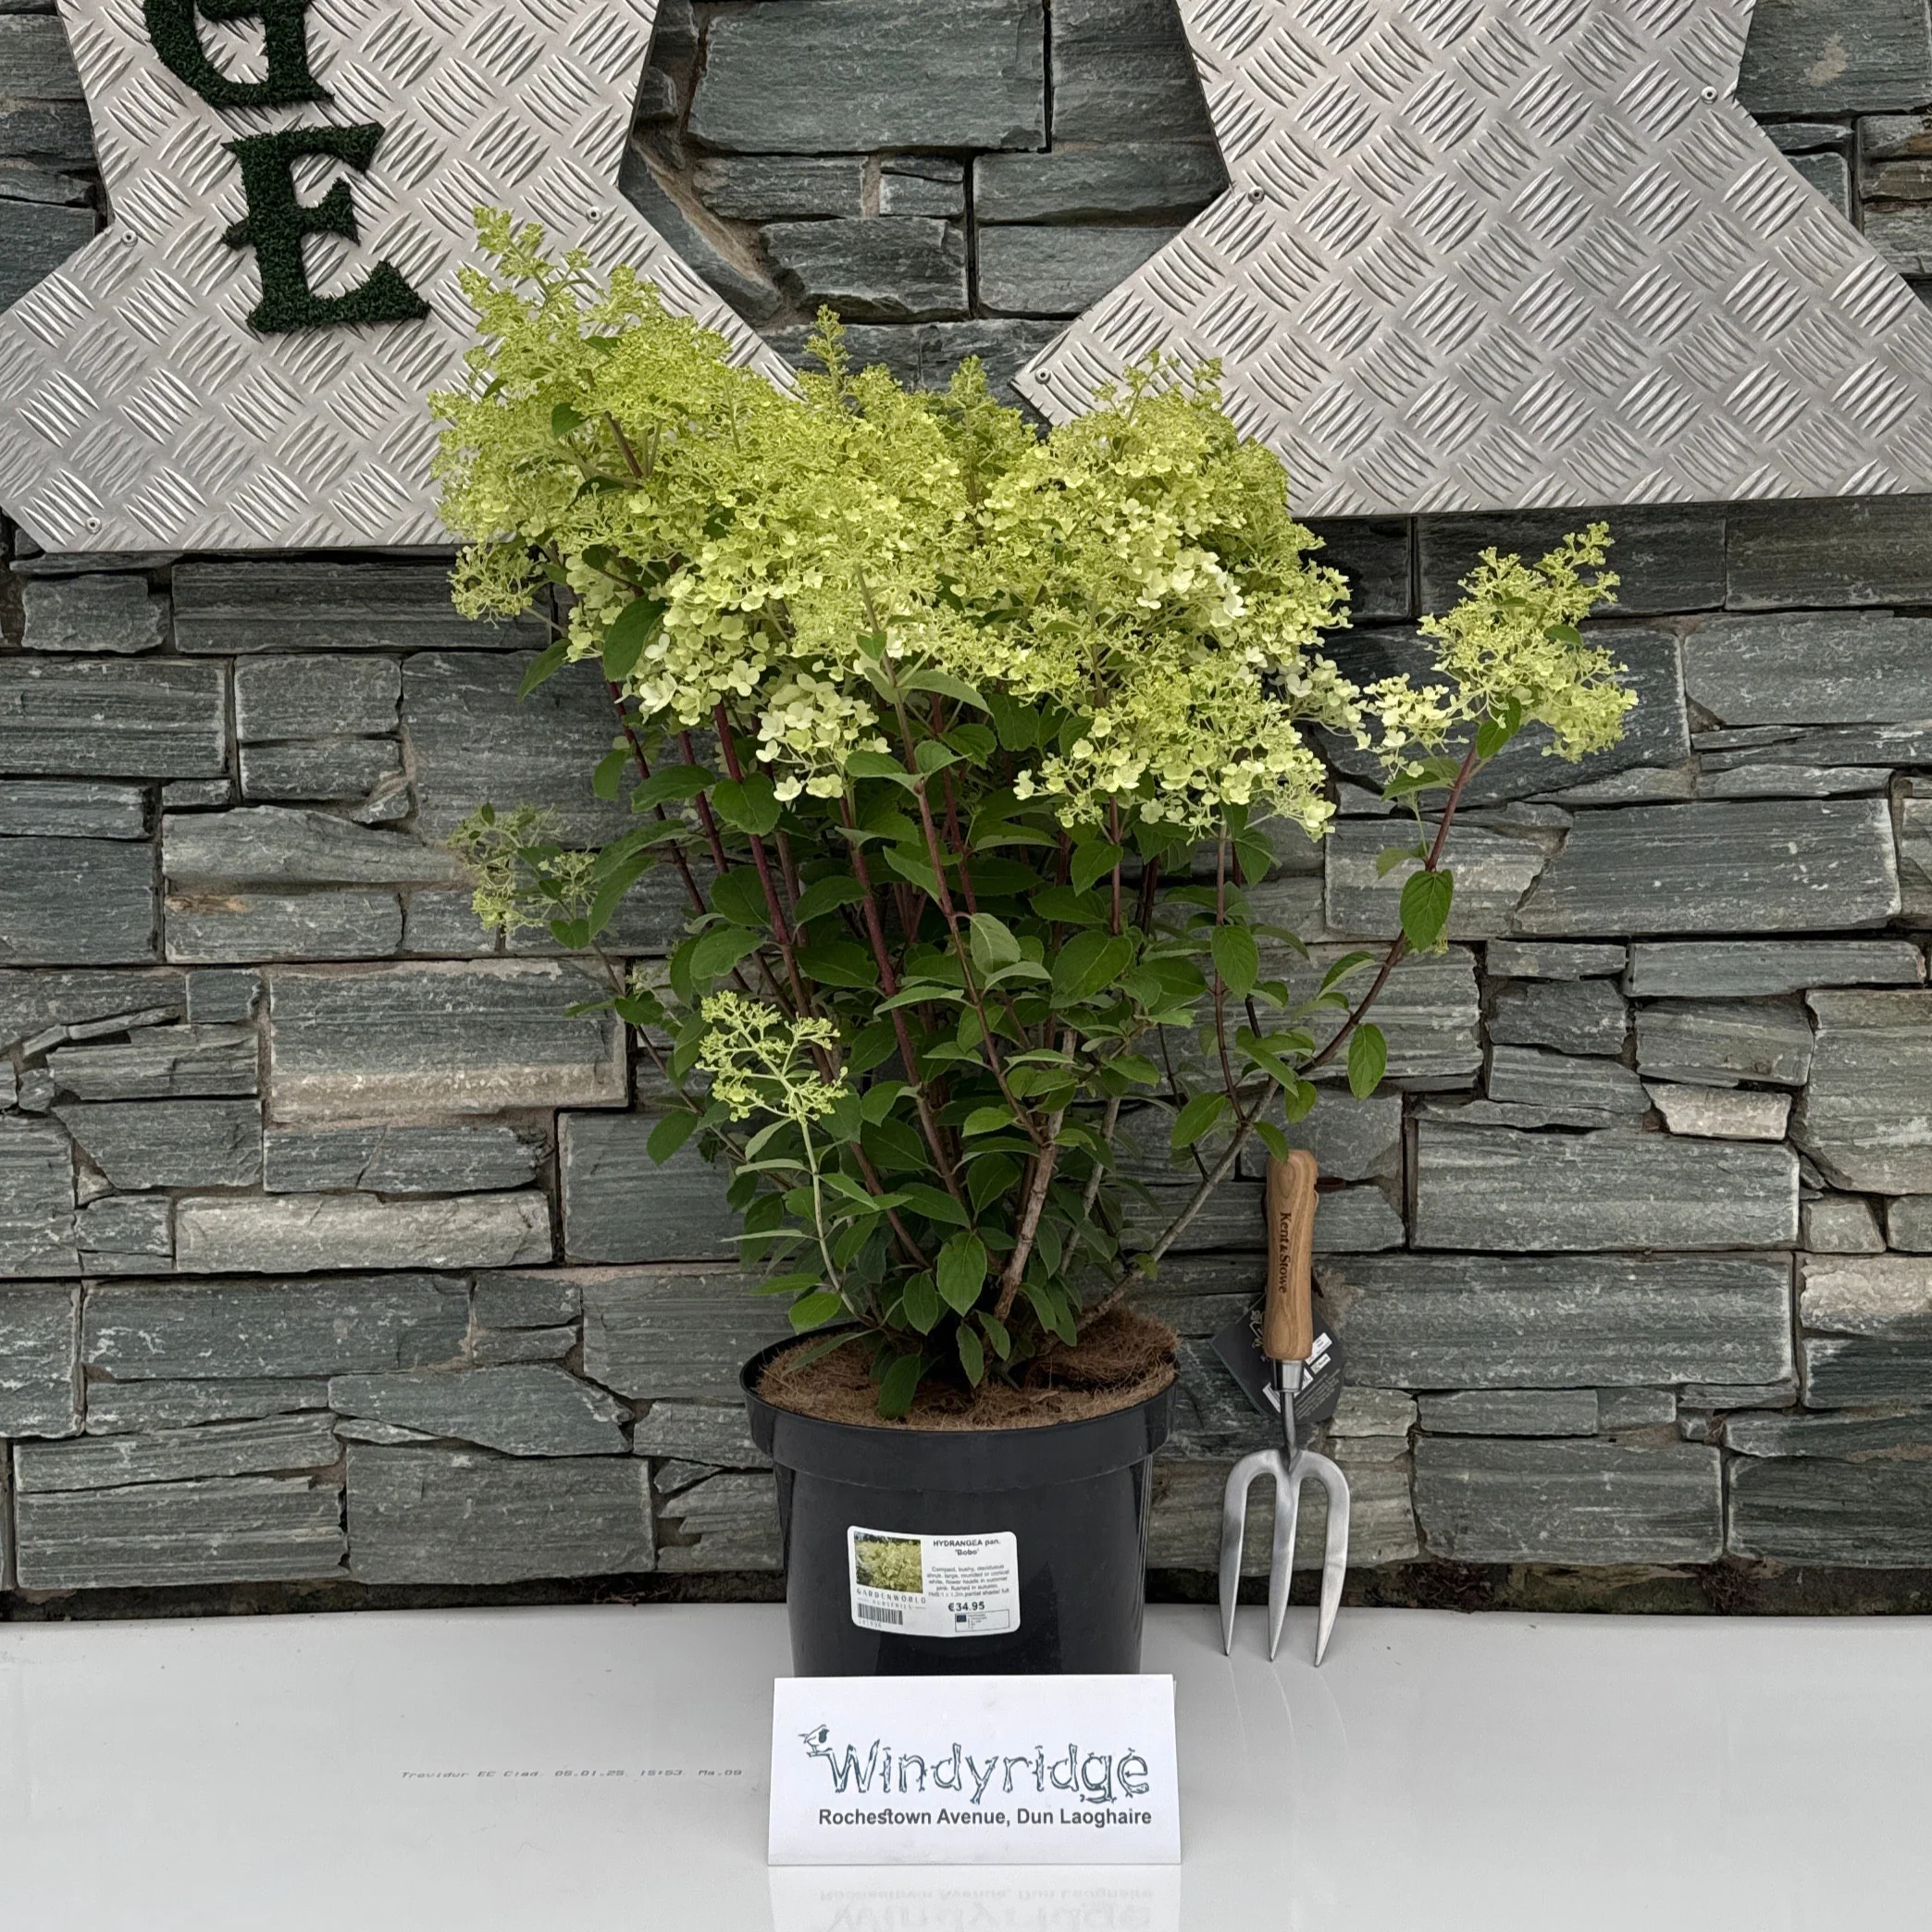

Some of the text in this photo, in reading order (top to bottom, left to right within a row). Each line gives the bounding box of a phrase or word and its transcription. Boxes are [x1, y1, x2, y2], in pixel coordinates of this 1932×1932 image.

[1280, 1212, 1292, 1243] Kent
[1279, 1255, 1292, 1294] Stowe
[933, 1538, 1001, 1547] HYDRANGEA pan.
[948, 1601, 985, 1612] €34.95
[807, 1739, 1150, 1805] Windyridge
[819, 1808, 1152, 1828] Rochestown Avenue, Dun Laoghaire
